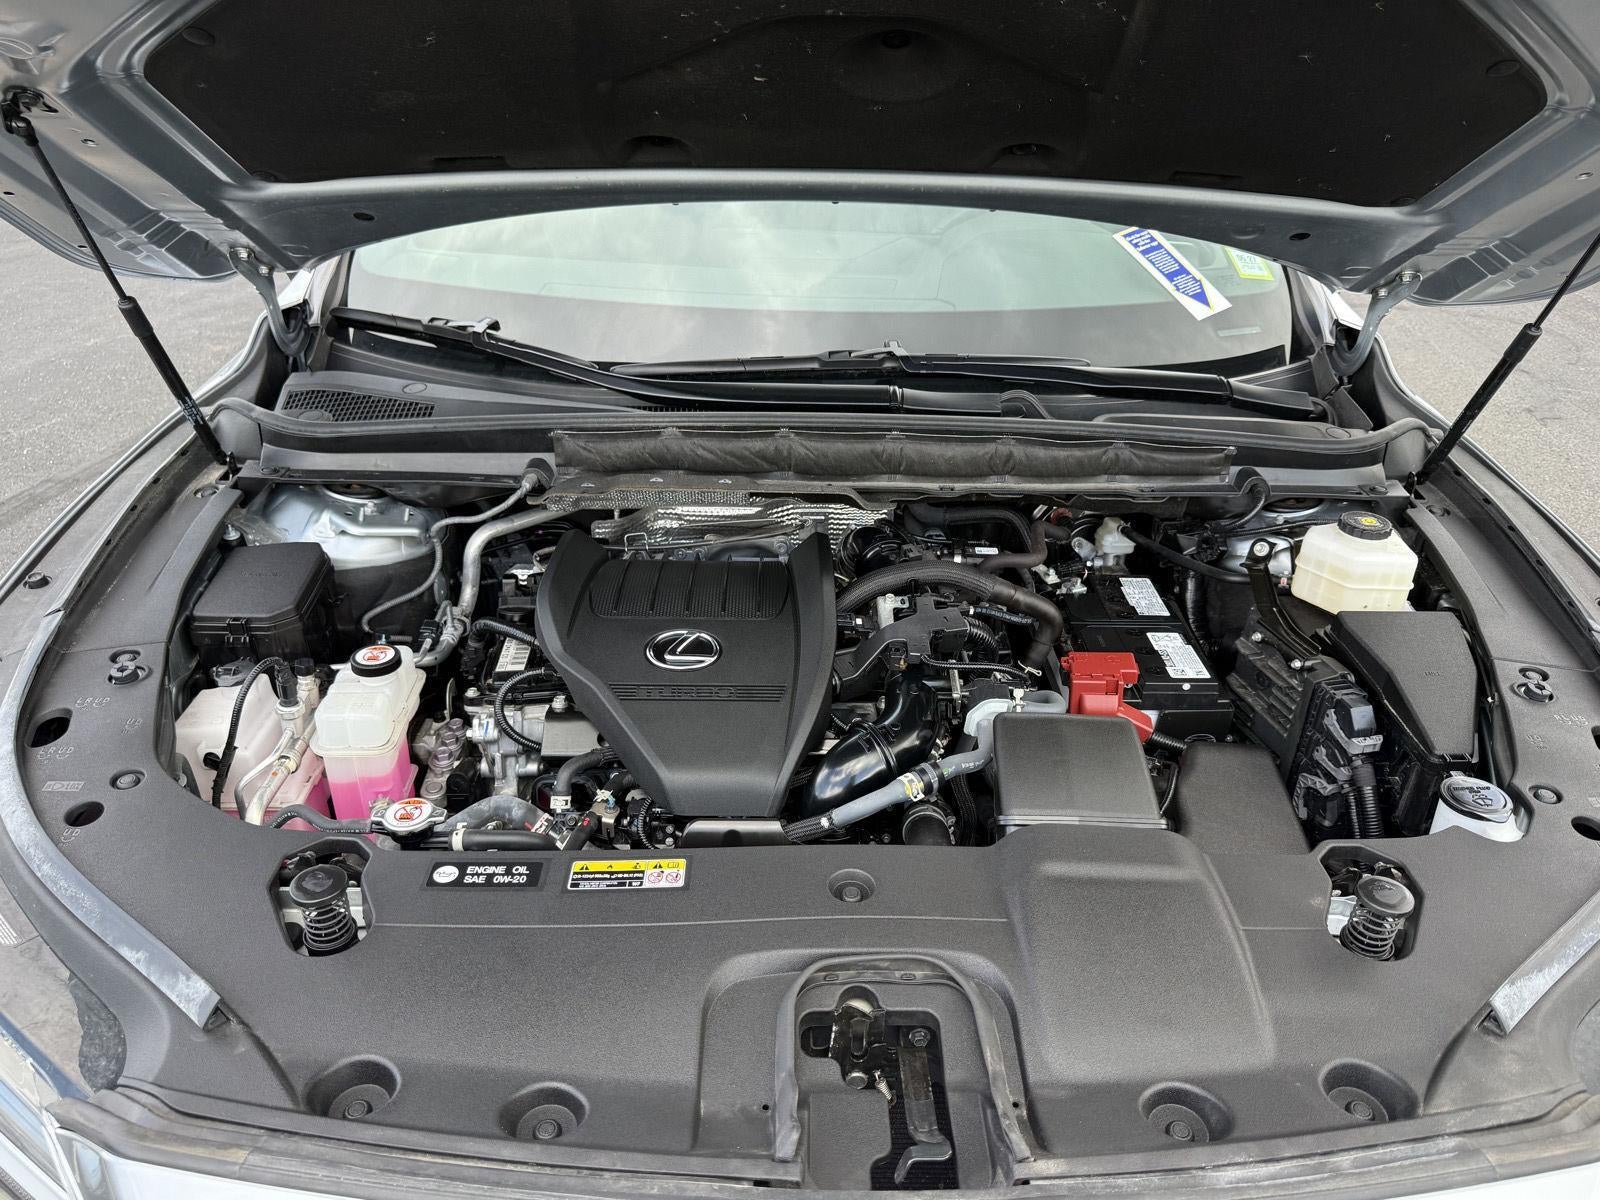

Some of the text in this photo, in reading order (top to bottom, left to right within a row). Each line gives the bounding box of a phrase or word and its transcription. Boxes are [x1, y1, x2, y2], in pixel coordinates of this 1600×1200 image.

[466, 866, 530, 874] ENGINE OIL
[463, 875, 527, 884] SAE 0W-20
